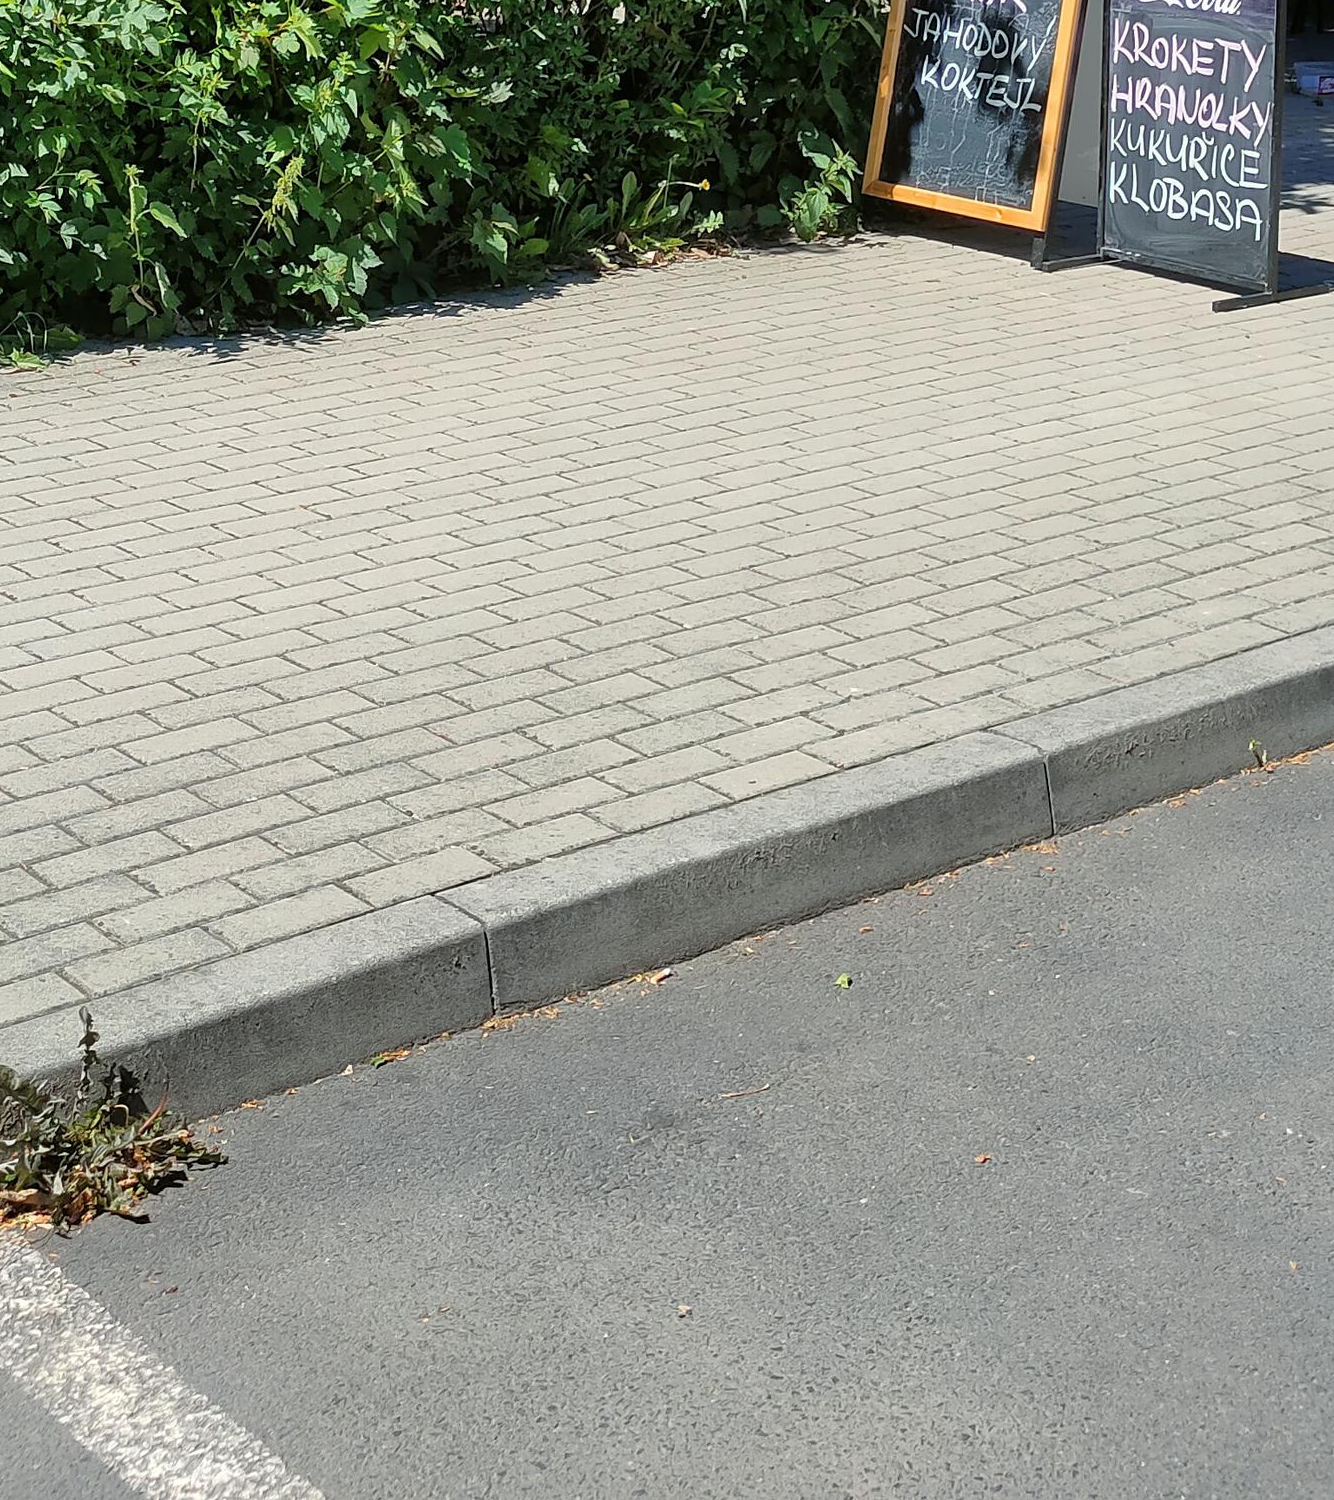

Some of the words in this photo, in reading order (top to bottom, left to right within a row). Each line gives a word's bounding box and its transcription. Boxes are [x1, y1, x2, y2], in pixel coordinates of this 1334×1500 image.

[921, 54, 1043, 113] KOKTEJL
[1113, 18, 1267, 93] KROKETY
[1111, 74, 1272, 148] HRANOLKY
[1110, 118, 1269, 190] KUKUŘICE
[1109, 161, 1263, 242] KLOBASA
